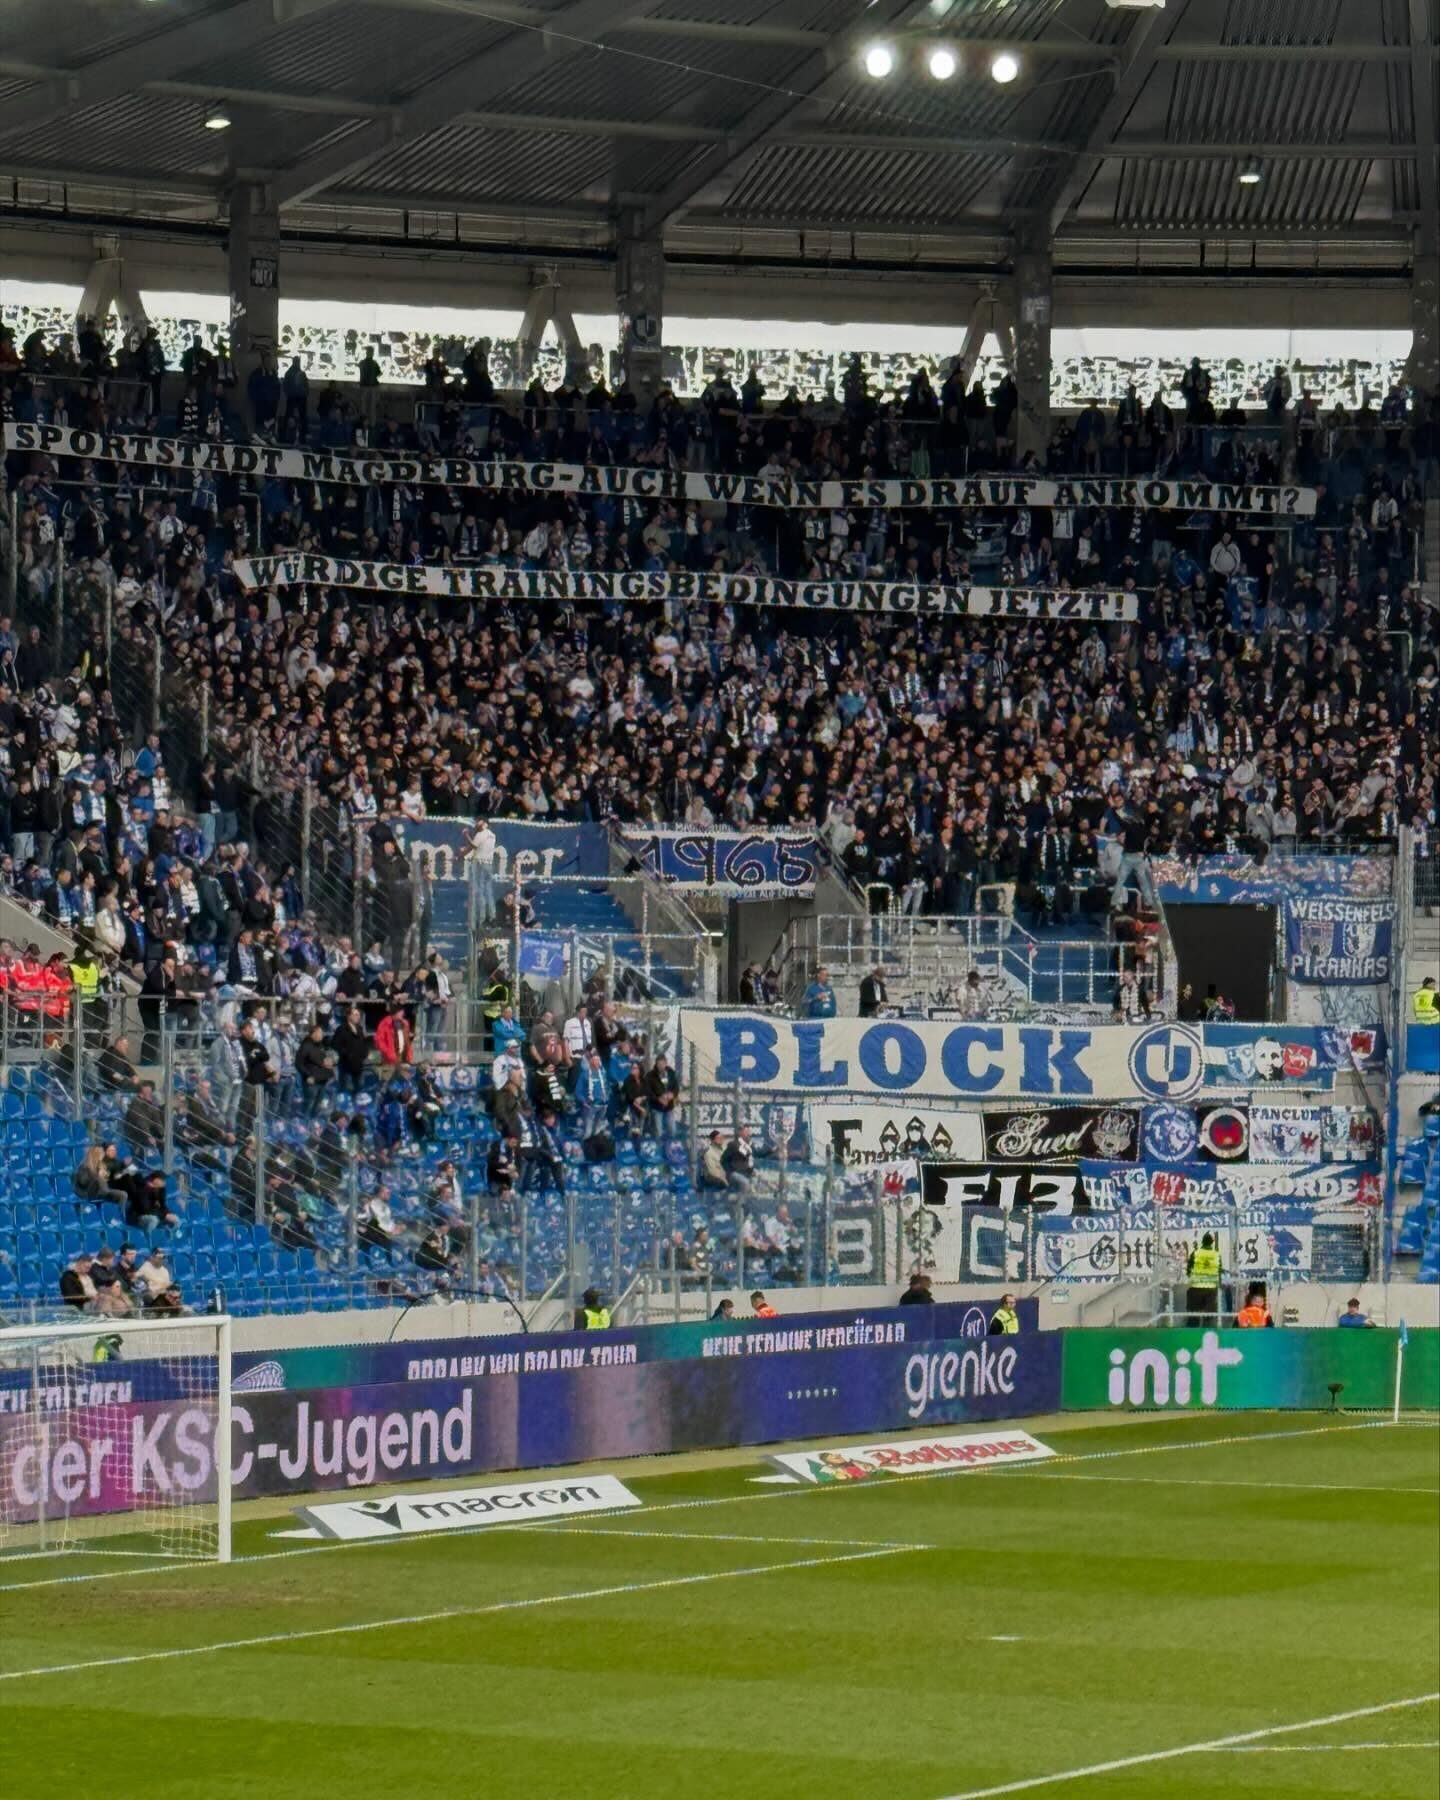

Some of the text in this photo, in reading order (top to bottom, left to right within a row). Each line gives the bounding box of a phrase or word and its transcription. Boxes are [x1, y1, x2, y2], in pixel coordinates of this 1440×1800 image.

[15, 424, 283, 475] SPORTSTADT
[703, 474, 822, 507] WENN
[842, 482, 887, 506] ES
[900, 481, 1038, 507] DRAUF
[1051, 481, 1301, 514] ANKOMMT?
[443, 568, 969, 613] TRAININGSBEDINGUNGEN
[989, 589, 1125, 618] JETZT!
[638, 835, 815, 888] 1965
[1290, 953, 1388, 979] PIRANHAS
[714, 1017, 1092, 1094] BLOCK
[904, 1341, 1018, 1419] grenke
[1107, 1331, 1244, 1406] init
[10, 1388, 473, 1507] der KSC-Jugend
[408, 1485, 602, 1520] macron
